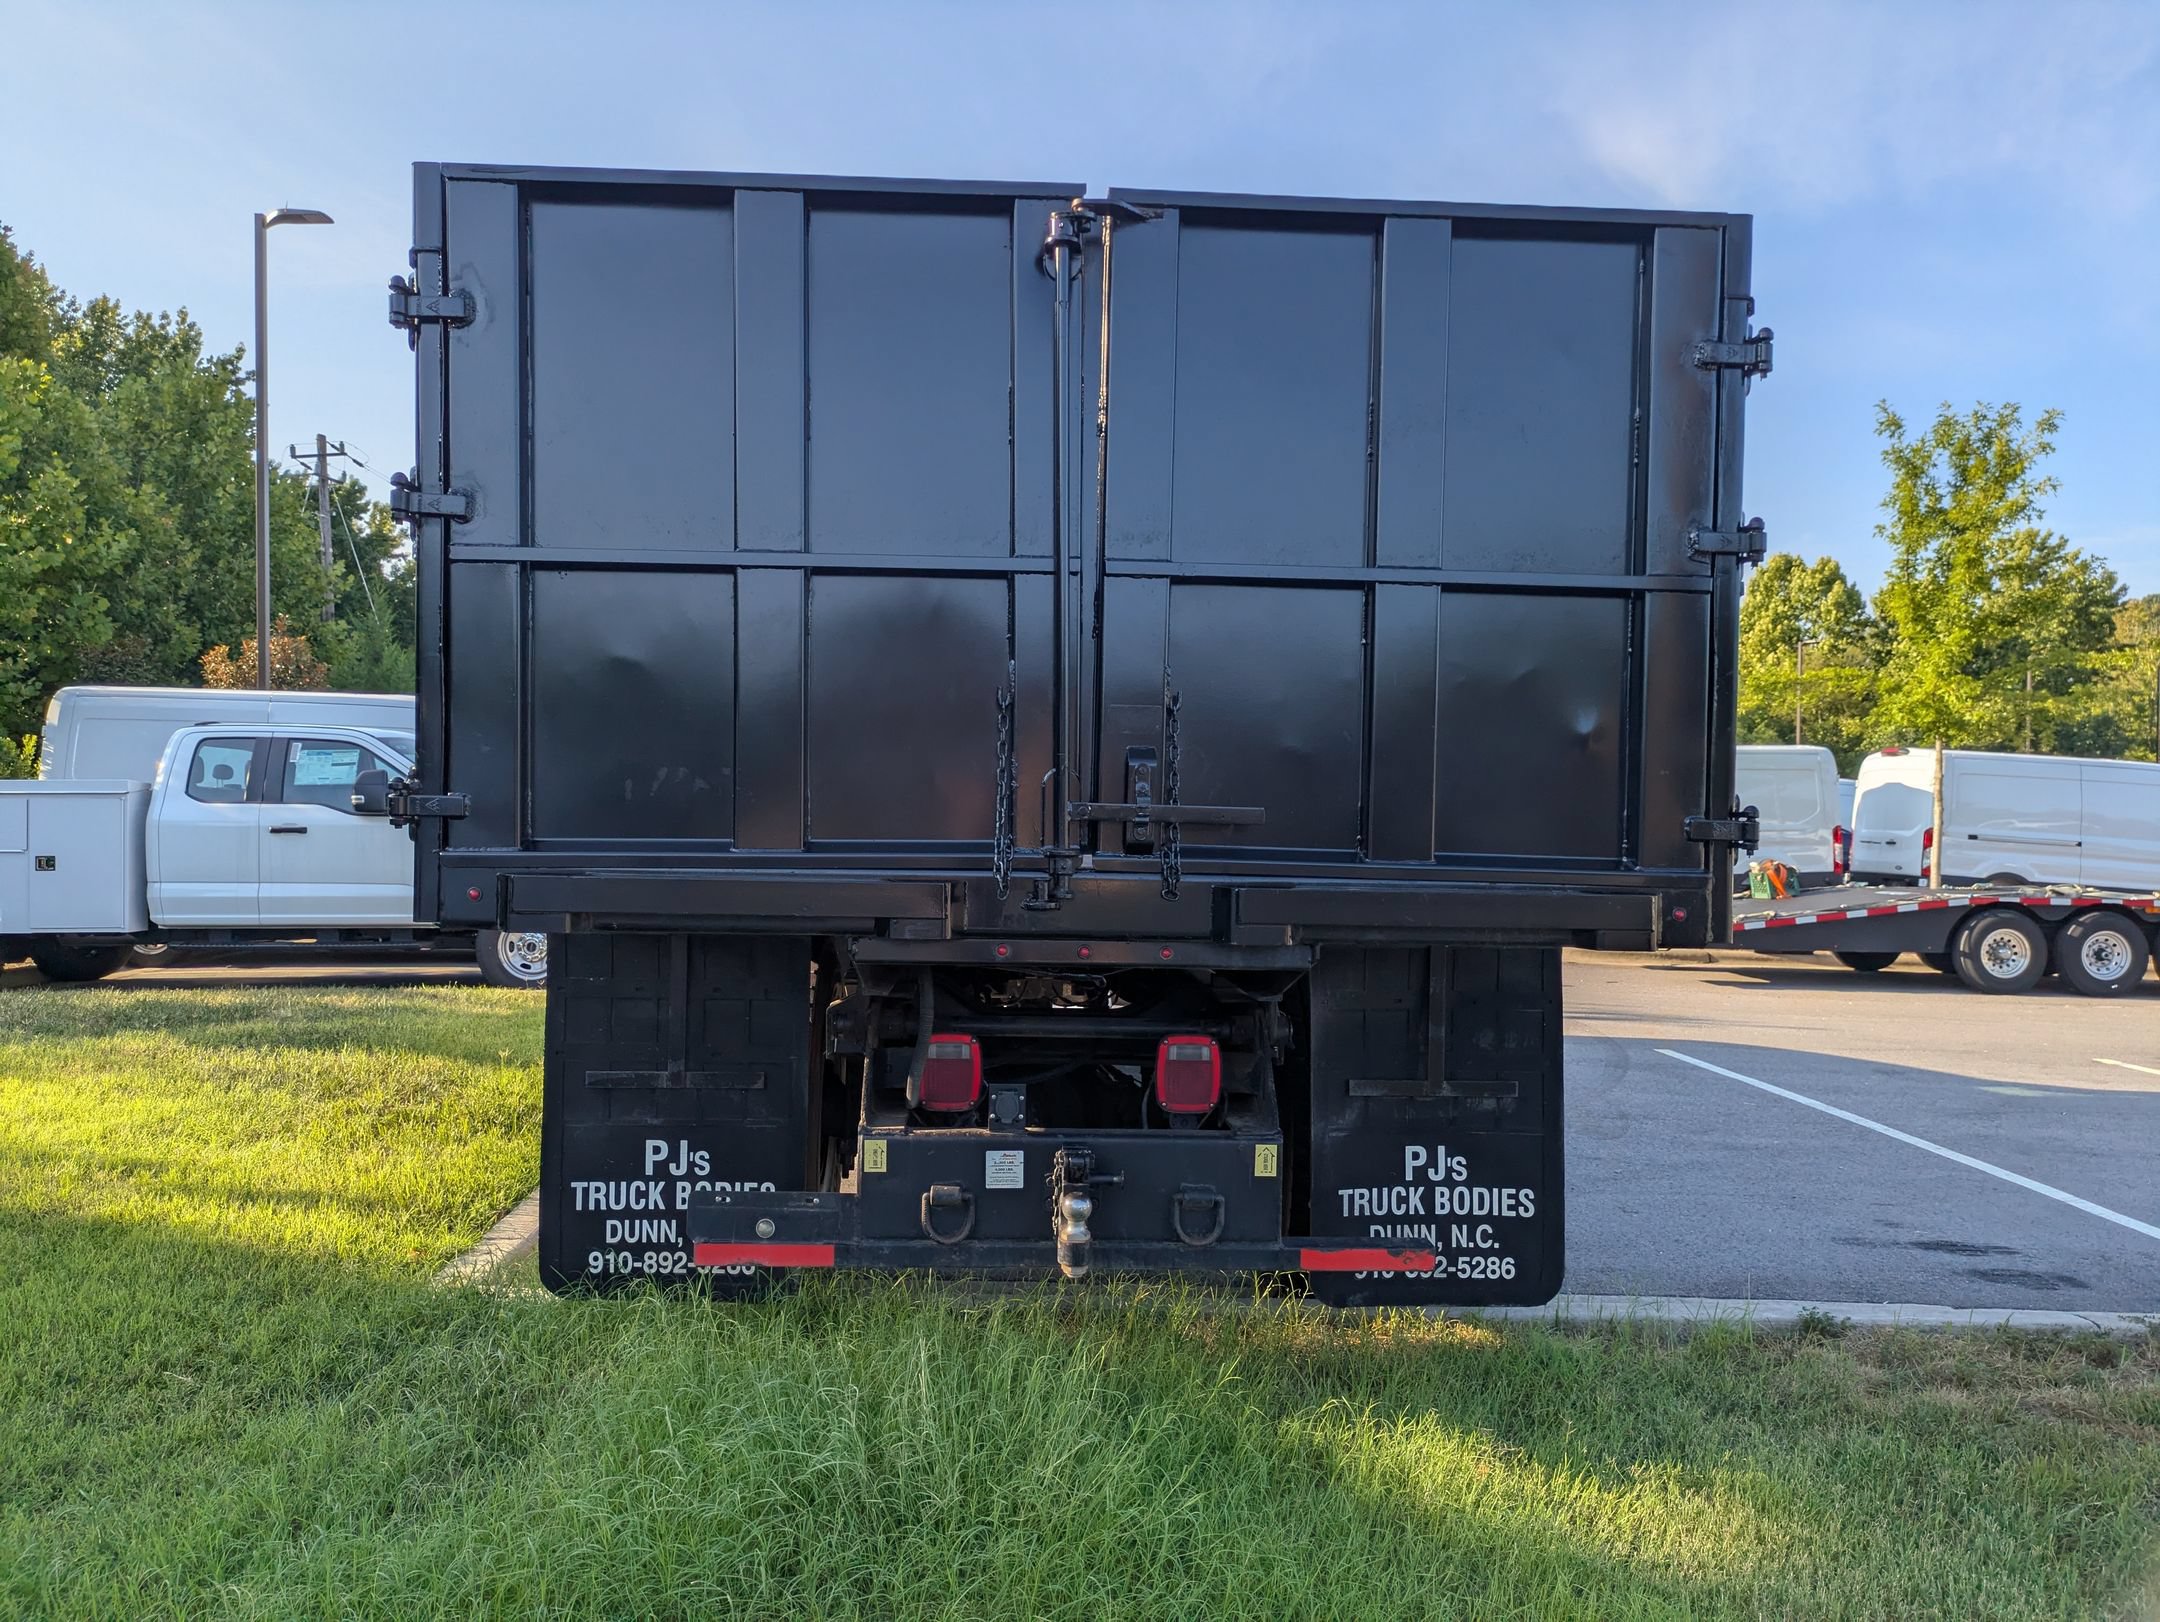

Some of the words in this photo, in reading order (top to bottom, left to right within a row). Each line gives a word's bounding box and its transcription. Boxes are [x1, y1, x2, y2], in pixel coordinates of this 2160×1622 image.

[570, 1181, 666, 1211] TRUCK
[1338, 1186, 1425, 1217] TRUCK
[1434, 1186, 1536, 1218] BODIES
[605, 1219, 683, 1248] DUNN,
[1451, 1223, 1500, 1249] N.C.
